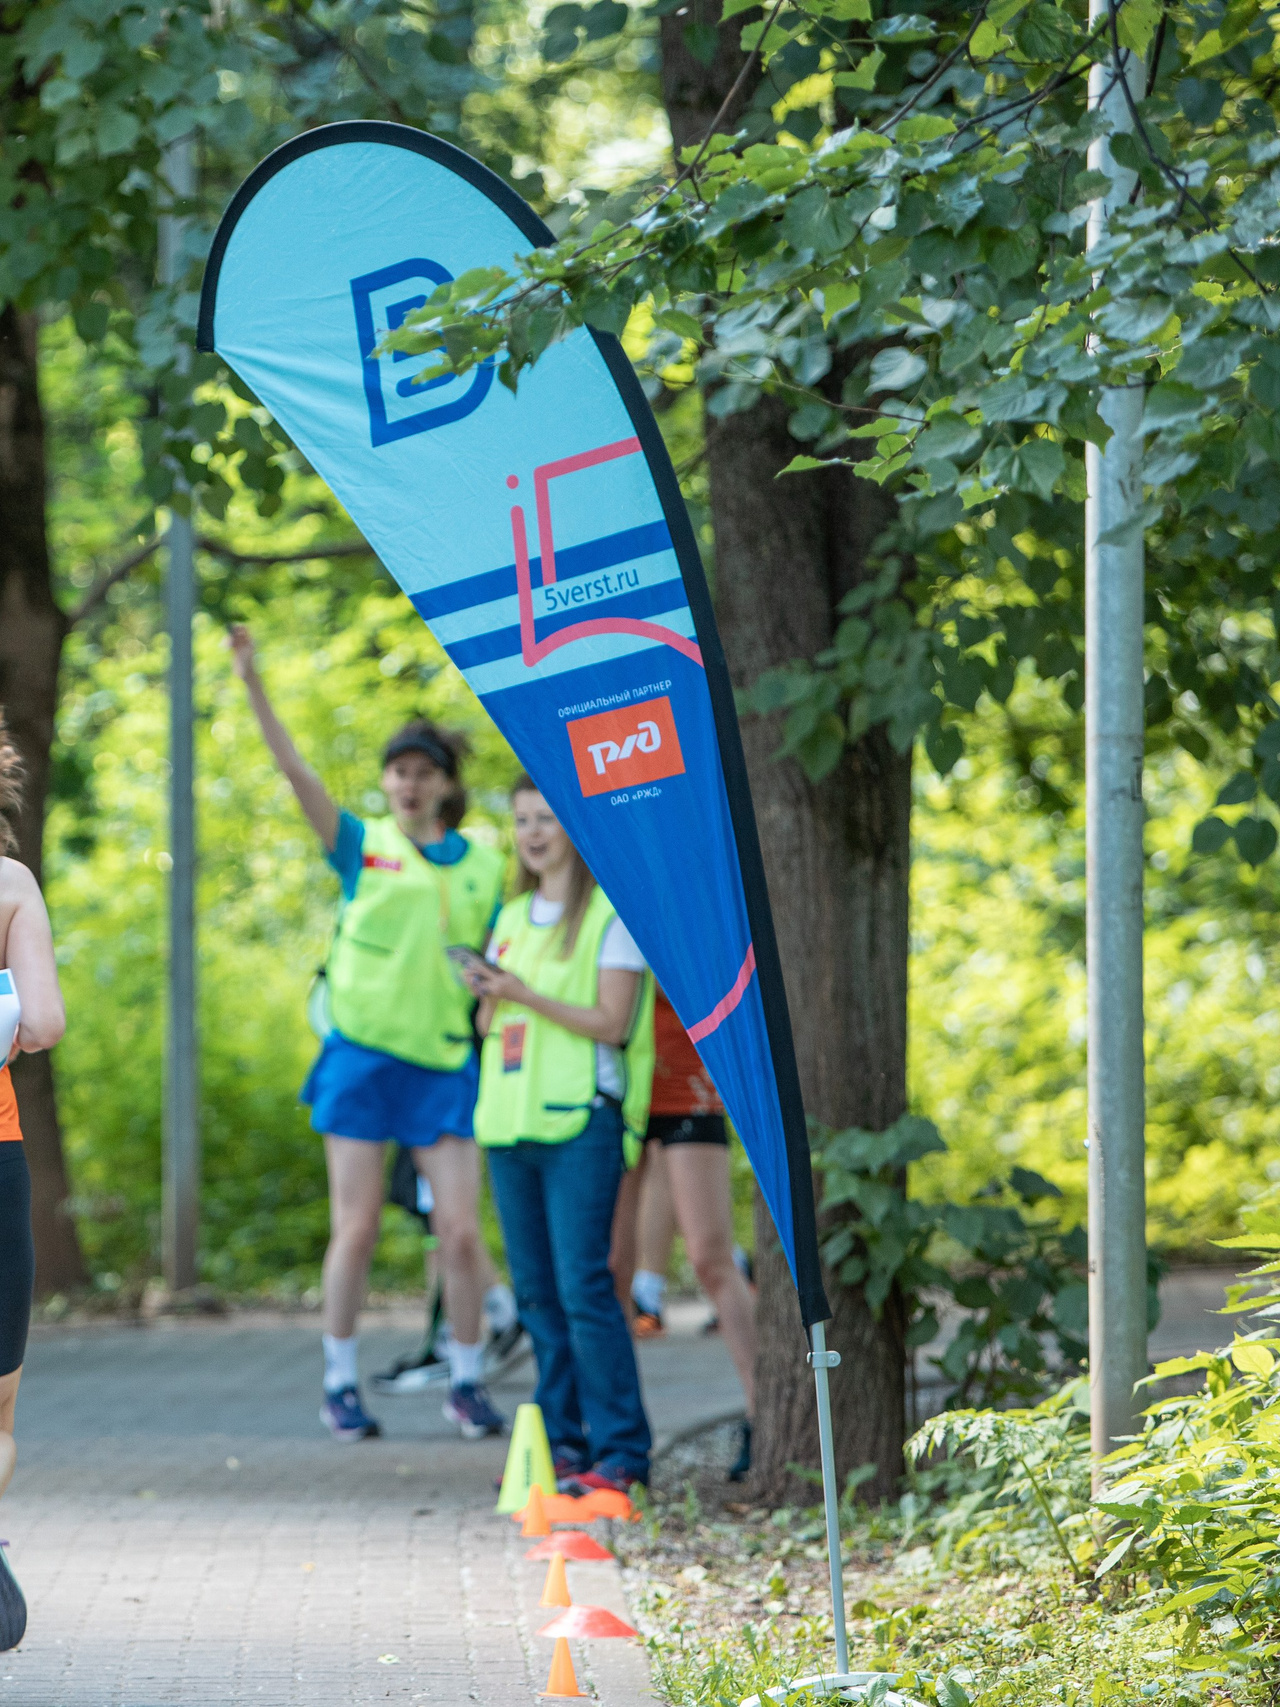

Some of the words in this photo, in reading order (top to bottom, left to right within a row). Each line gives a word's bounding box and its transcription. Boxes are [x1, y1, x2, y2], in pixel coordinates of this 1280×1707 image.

[544, 568, 640, 611] 5verst.ru
[558, 689, 631, 718] ОФИЦИАЛЬНЫЙ
[632, 679, 672, 699] ПАРТНЕР
[610, 791, 629, 806] ОАО
[632, 786, 662, 801] «РЖД»
